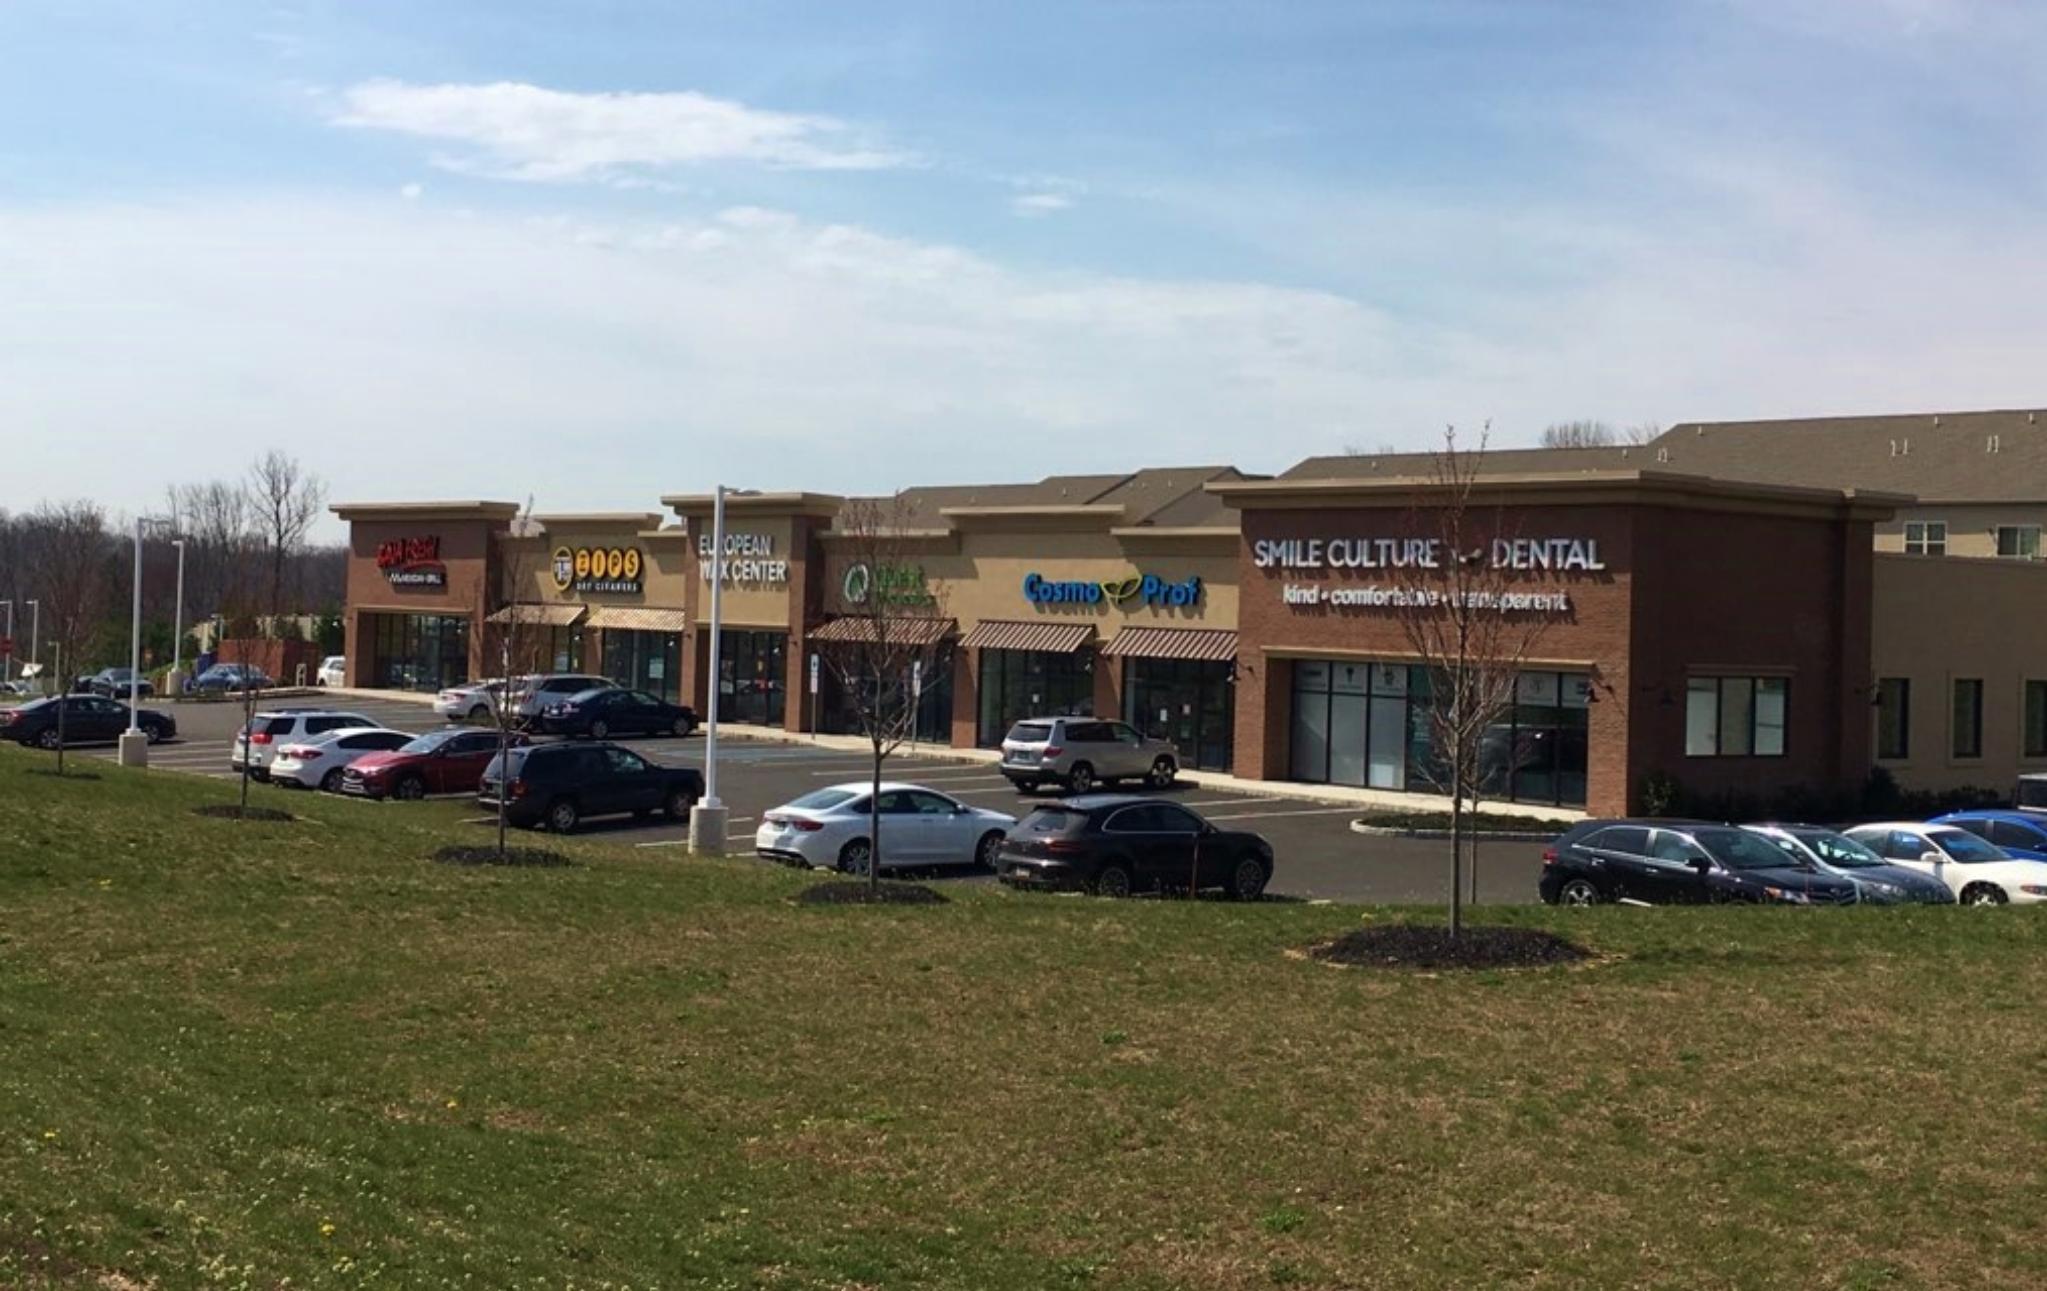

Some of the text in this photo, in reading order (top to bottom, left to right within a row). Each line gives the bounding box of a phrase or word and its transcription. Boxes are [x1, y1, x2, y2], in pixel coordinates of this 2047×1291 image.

[577, 550, 639, 577] ZIPS
[1254, 538, 1606, 570] SMILE CULTURE DENTAL
[699, 560, 786, 581] WX CENTER
[1023, 573, 1198, 606] Cosmo Prof
[1283, 583, 1319, 605] kind
